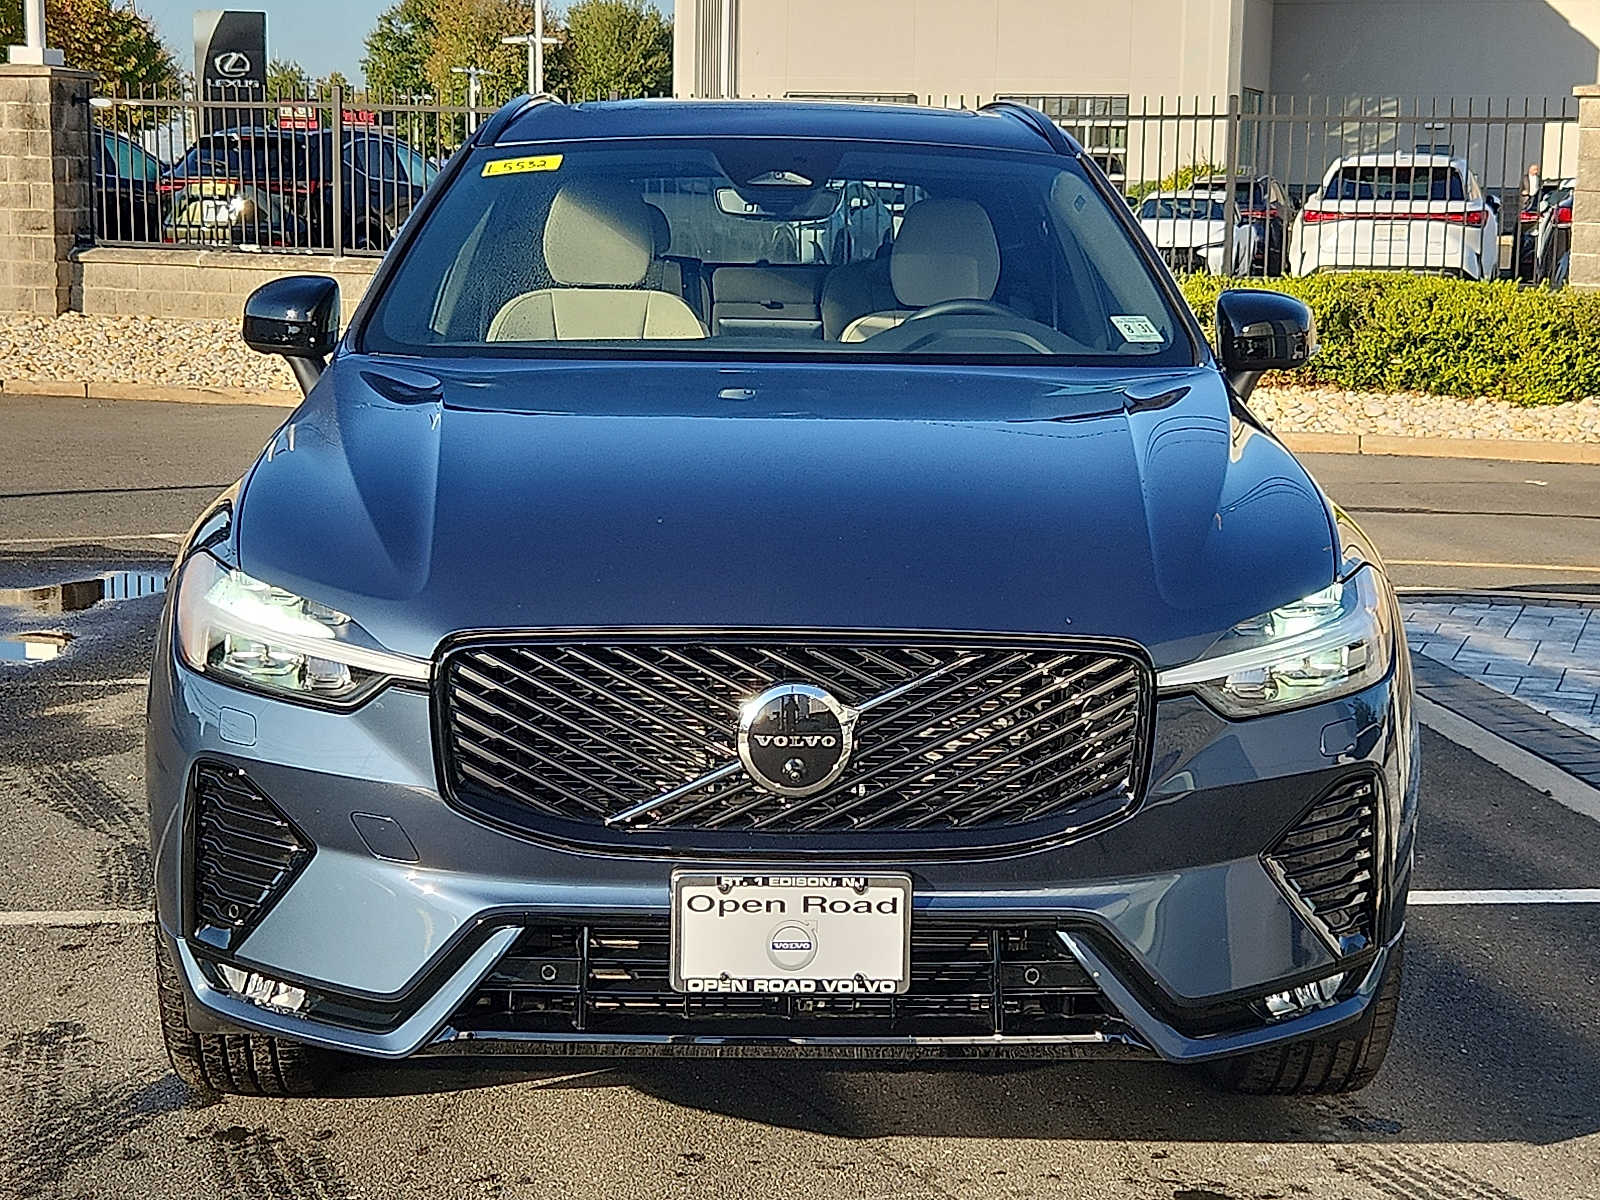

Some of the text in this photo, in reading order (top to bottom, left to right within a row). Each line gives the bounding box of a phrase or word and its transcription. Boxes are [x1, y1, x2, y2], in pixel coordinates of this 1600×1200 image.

[753, 735, 836, 747] VOLVO
[754, 876, 763, 887] 1
[687, 894, 898, 917] Open Road
[773, 942, 811, 950] VOLVO
[687, 979, 896, 993] OPEN ROAD VOLVO
